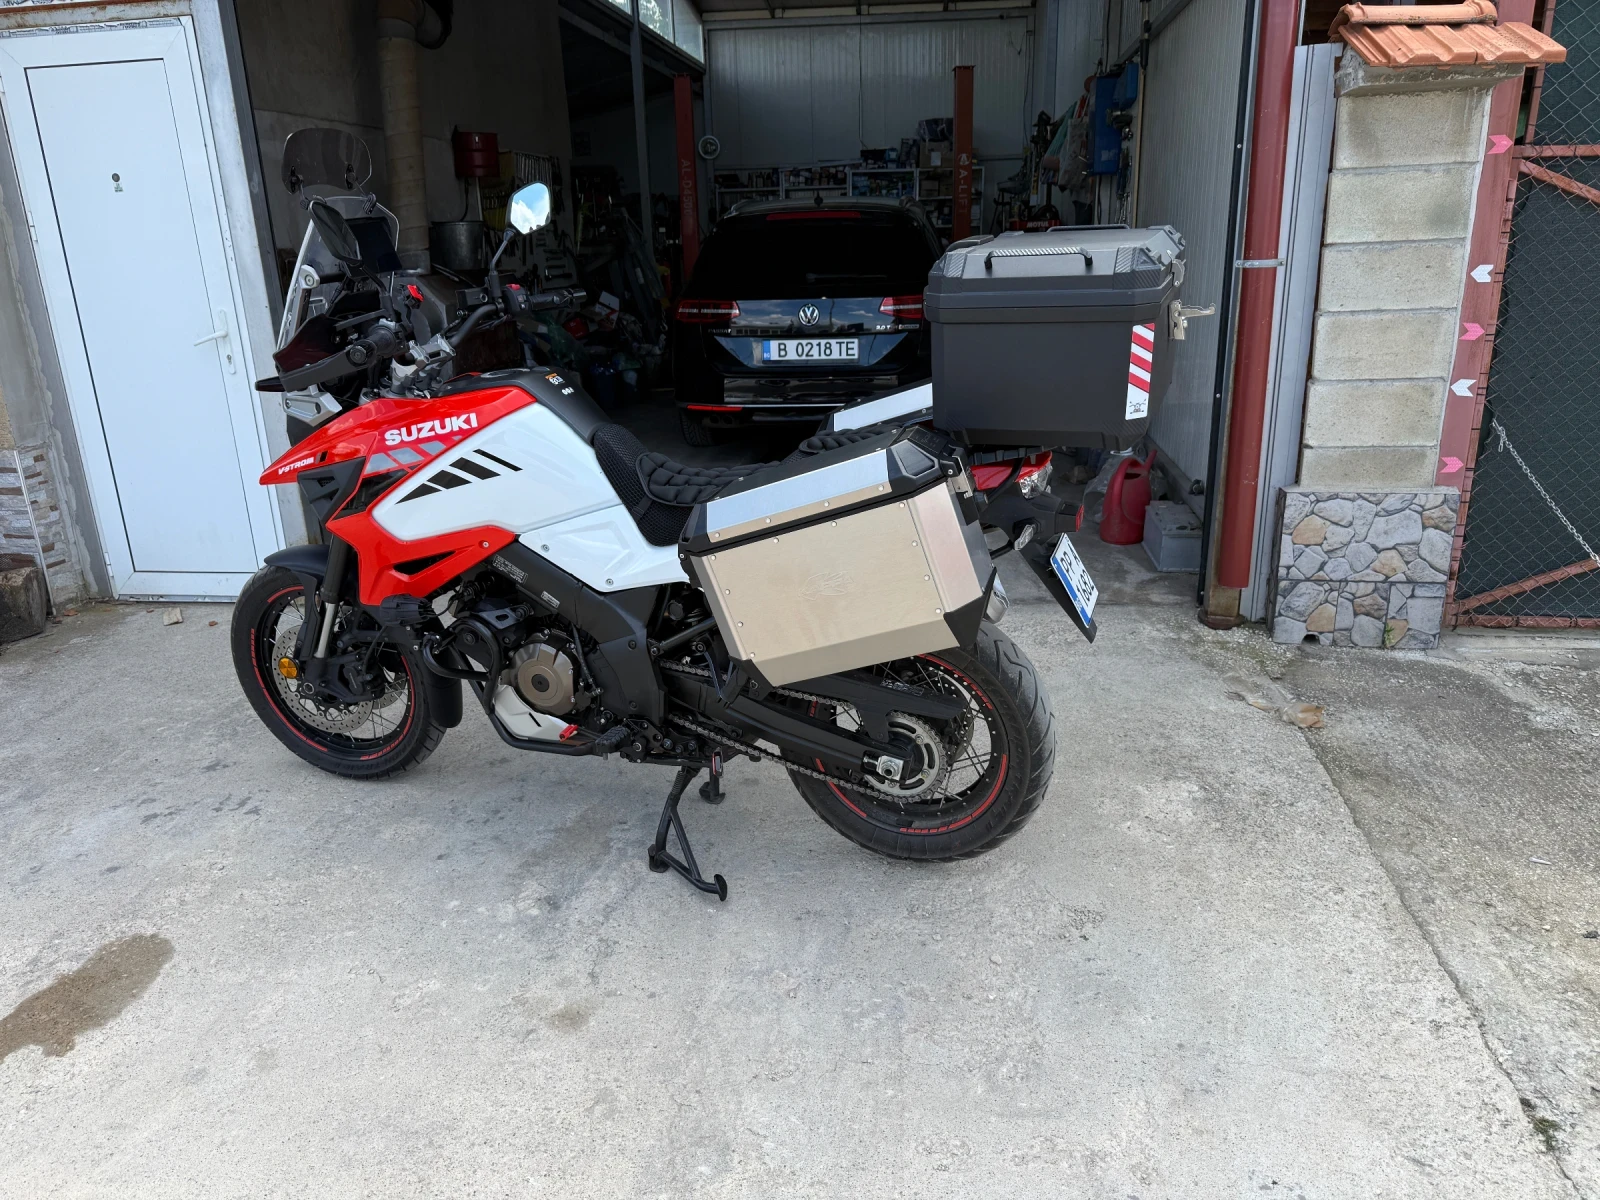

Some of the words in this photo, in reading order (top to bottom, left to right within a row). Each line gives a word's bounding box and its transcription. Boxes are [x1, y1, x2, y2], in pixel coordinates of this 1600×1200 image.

[681, 158, 693, 216] AL-D4500
[958, 168, 969, 213] A-LIFT
[1026, 220, 1049, 228] MOTUL
[777, 342, 788, 358] B
[795, 341, 833, 358] 0218
[835, 340, 856, 357] TE
[384, 412, 479, 446] SUZUKI
[278, 456, 315, 475] V-STROM
[1060, 551, 1075, 581] PP
[1075, 568, 1095, 608] 1682
